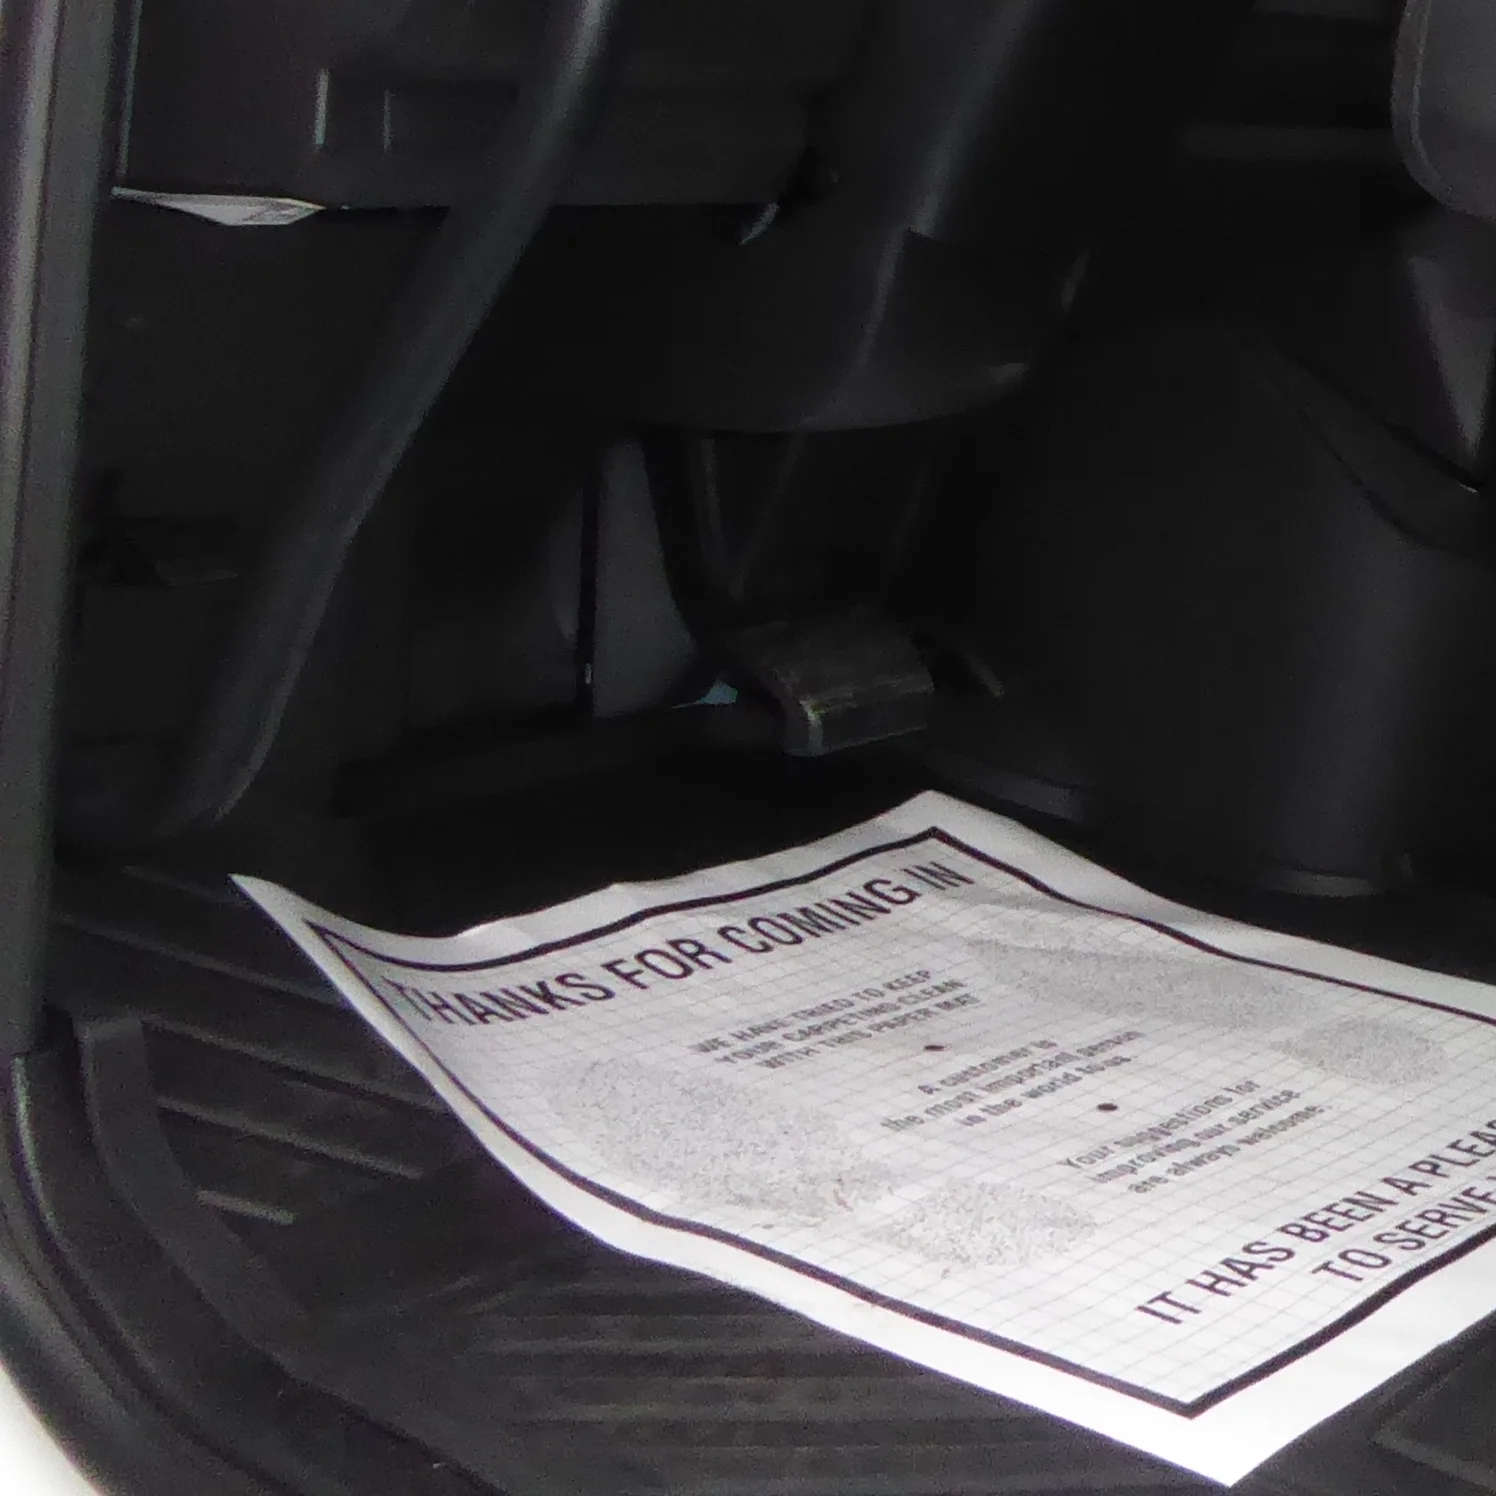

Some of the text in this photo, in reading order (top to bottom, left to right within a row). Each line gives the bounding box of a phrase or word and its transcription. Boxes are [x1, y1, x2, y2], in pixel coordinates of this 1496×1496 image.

[381, 861, 976, 1026] THANKS FOR COMING IN
[852, 987, 887, 1002] TO
[882, 969, 931, 991] KEEP
[714, 1040, 783, 1064] YOUR
[755, 1046, 821, 1069] WITH
[867, 1008, 939, 1033] PAPER
[935, 992, 980, 1011] MAT
[880, 1115, 925, 1130] the
[924, 1091, 983, 1117] most
[978, 1052, 1081, 1094] important
[918, 1083, 942, 1094] A
[939, 1047, 1032, 1086] customer
[980, 1098, 1022, 1115] the
[1057, 1080, 1260, 1169] Your suggestions for
[1084, 1089, 1301, 1183] improving our service
[1129, 1176, 1170, 1194] are
[1166, 1144, 1241, 1176] always
[1135, 1291, 1201, 1324] IT
[1185, 1241, 1295, 1297] HAS
[1276, 1191, 1399, 1243] BEEN
[1380, 1176, 1431, 1196] A
[1311, 1248, 1392, 1282] TO
